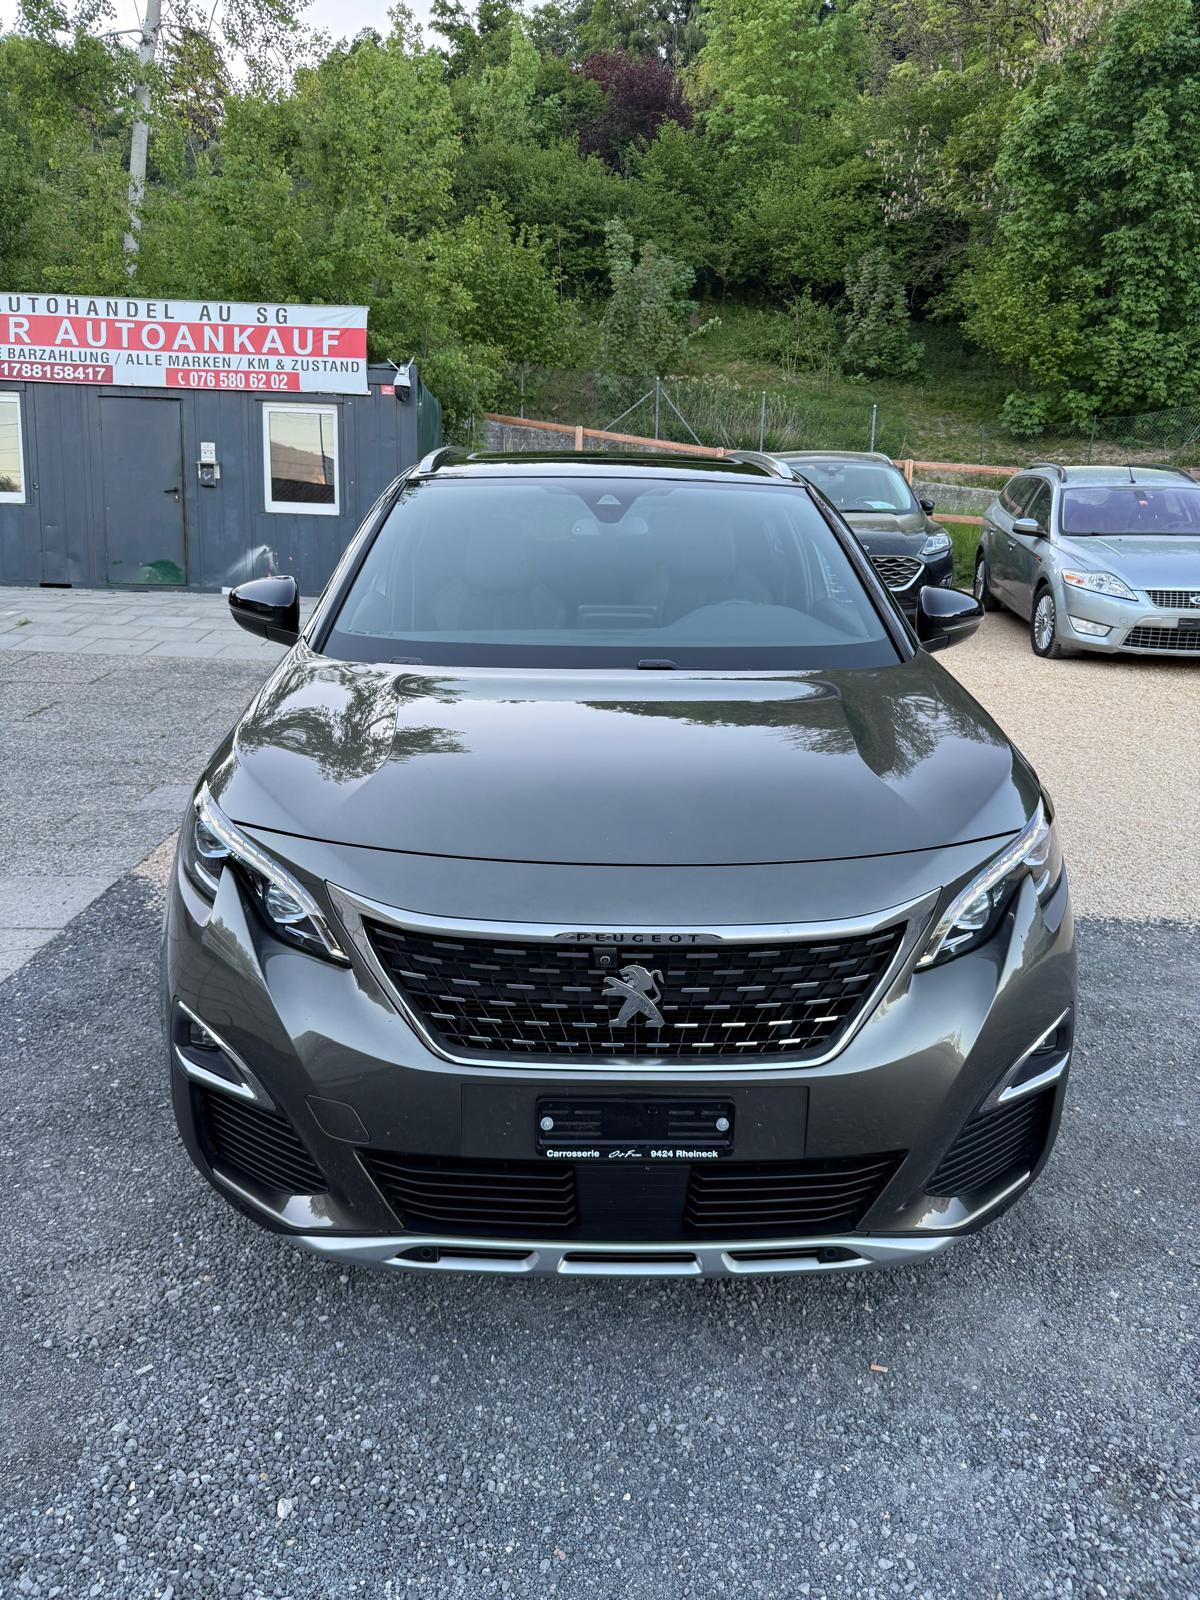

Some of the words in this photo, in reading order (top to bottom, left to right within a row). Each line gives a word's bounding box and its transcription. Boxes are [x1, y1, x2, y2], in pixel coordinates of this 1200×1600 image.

[0, 296, 175, 319] UTOHANDEL
[199, 305, 231, 322] AU
[256, 307, 288, 324] SG
[8, 316, 31, 343] R
[55, 318, 340, 355] AUTOANKAUF
[8, 347, 110, 364] BARZAHLUNG
[126, 353, 162, 366] ALLE
[168, 355, 231, 368] MARKEN
[247, 358, 269, 370] KM
[276, 358, 285, 371] &
[291, 359, 360, 373] ZUSTAND
[0, 362, 106, 380] 1788158417
[189, 371, 215, 387] 076
[219, 372, 245, 388] 580
[249, 373, 267, 388] 62
[270, 374, 288, 389] 02
[576, 933, 699, 943] PEUGEOT
[546, 1149, 600, 1158] Carrosserie
[650, 1149, 674, 1158] 9424
[675, 1149, 719, 1158] Rheineck
